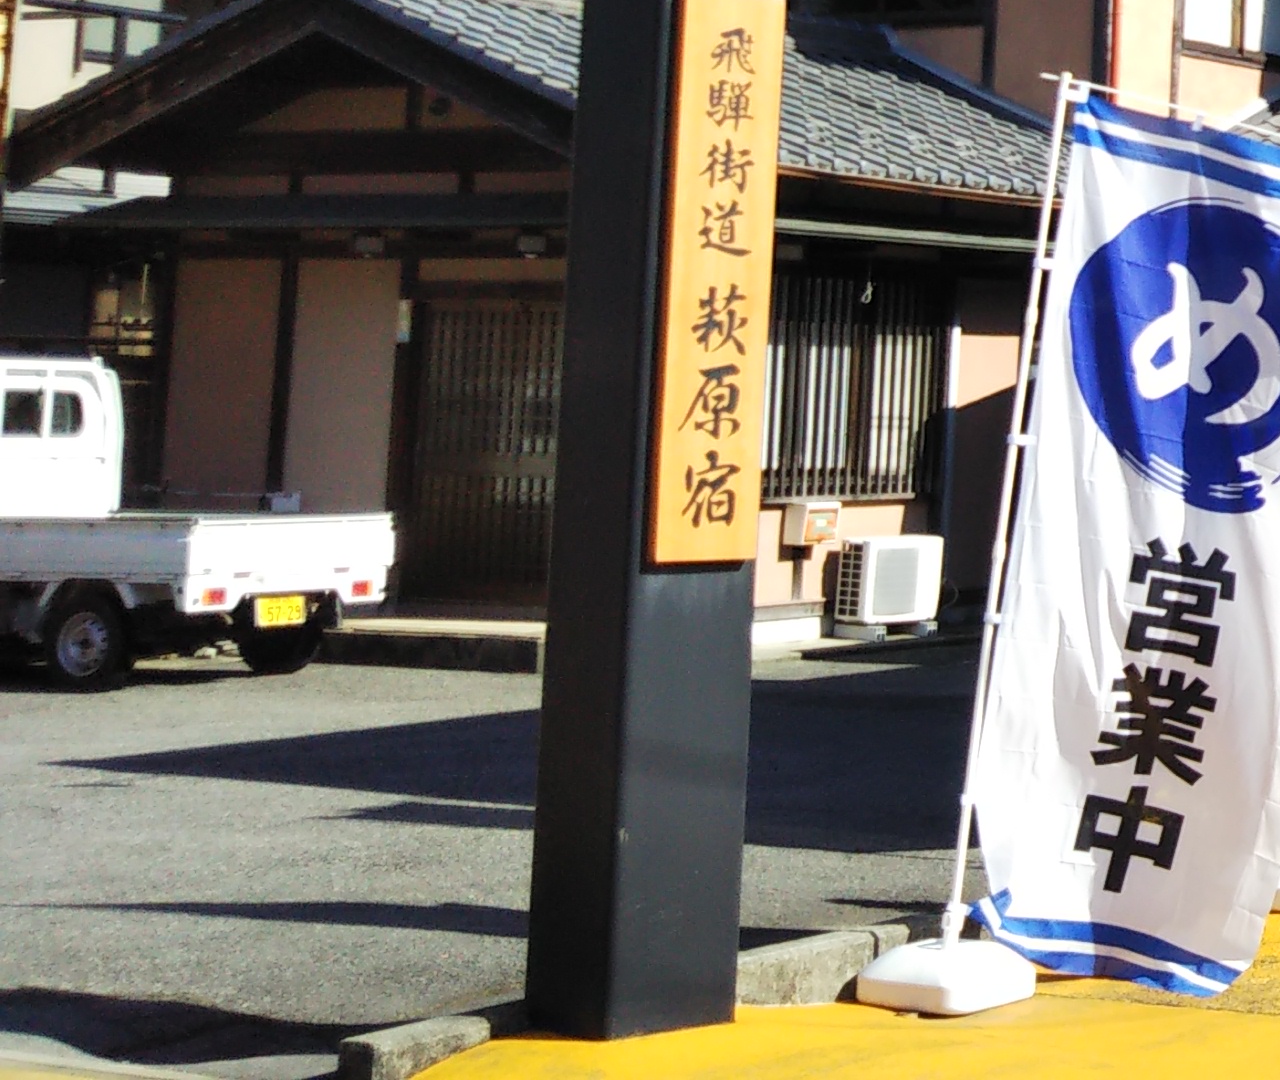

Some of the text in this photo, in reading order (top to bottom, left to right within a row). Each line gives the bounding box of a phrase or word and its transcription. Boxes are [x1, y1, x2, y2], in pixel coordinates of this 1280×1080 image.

[678, 283, 749, 529] 萩原宿
[267, 605, 301, 622] 57-29
[1077, 537, 1234, 893] 営業中
